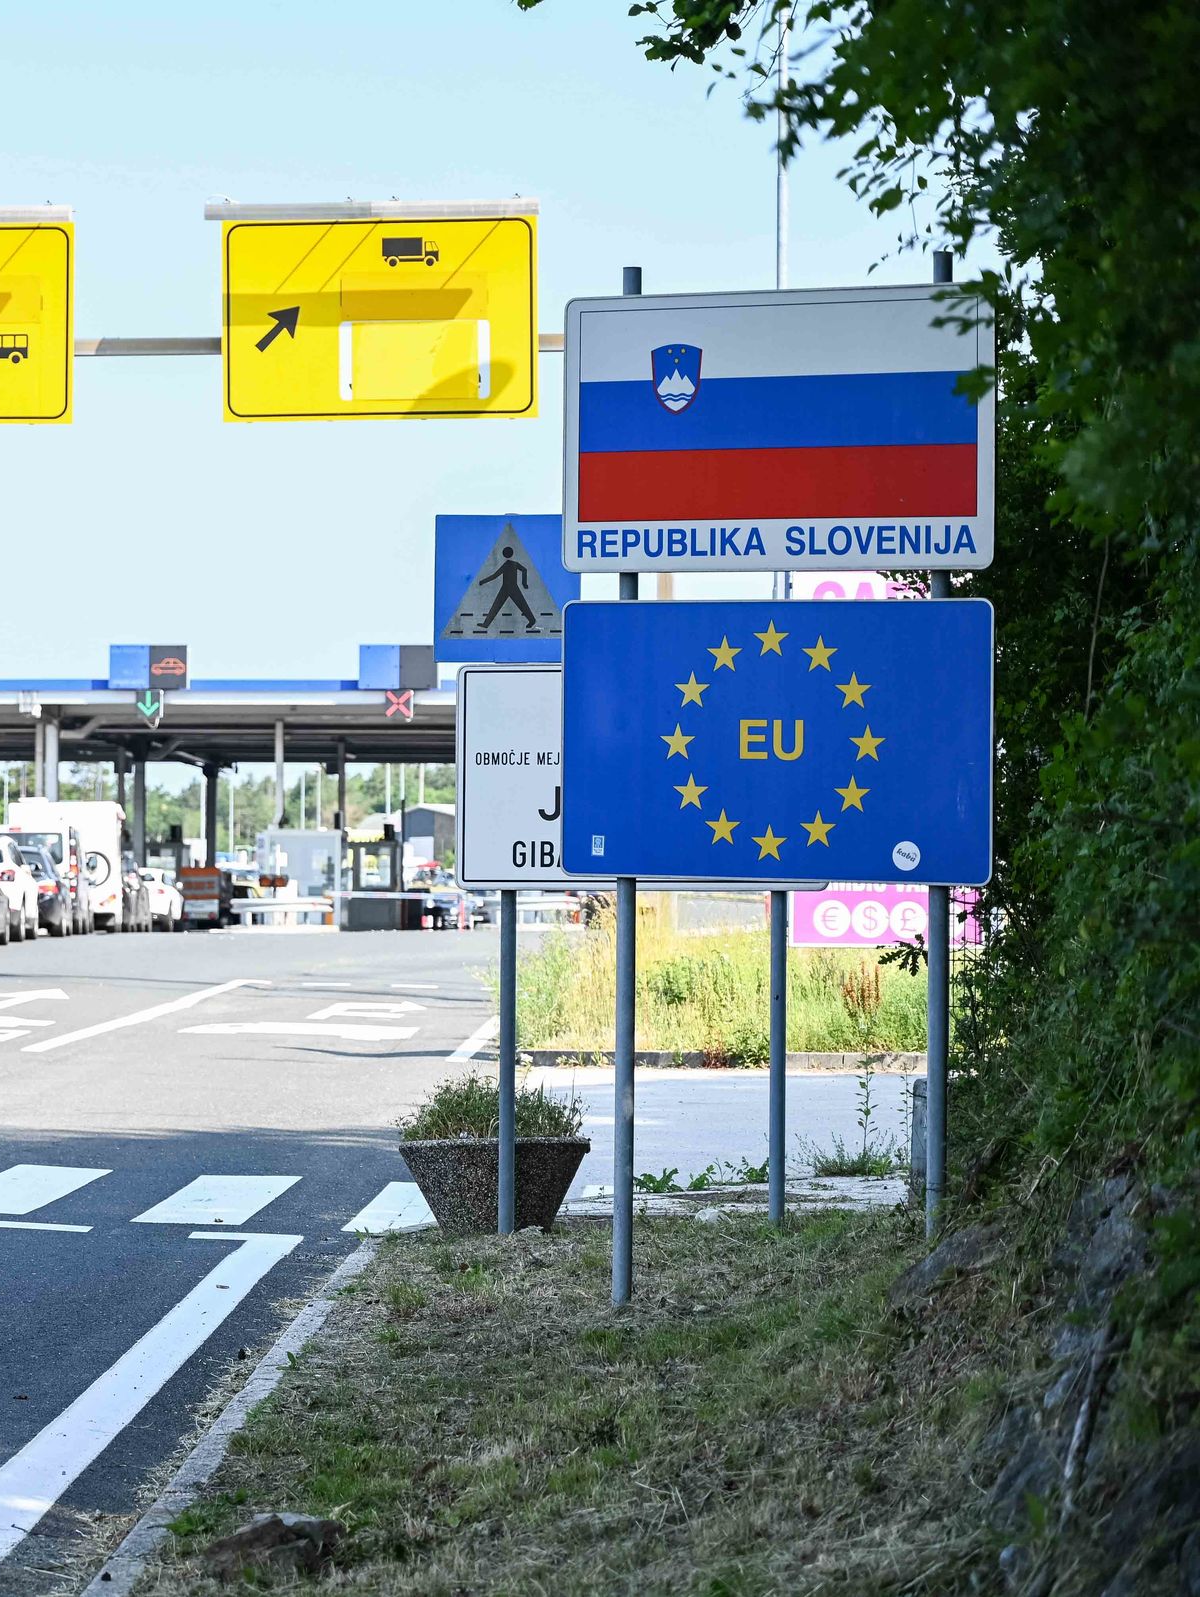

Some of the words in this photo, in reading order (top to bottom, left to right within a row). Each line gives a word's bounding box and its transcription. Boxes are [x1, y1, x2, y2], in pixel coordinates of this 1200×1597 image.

[577, 527, 767, 558] REPUBLIKA
[785, 524, 978, 556] SLOVENIJA
[739, 719, 804, 761] EU
[475, 749, 530, 766] OBMOČJE
[512, 840, 561, 868] GIB
